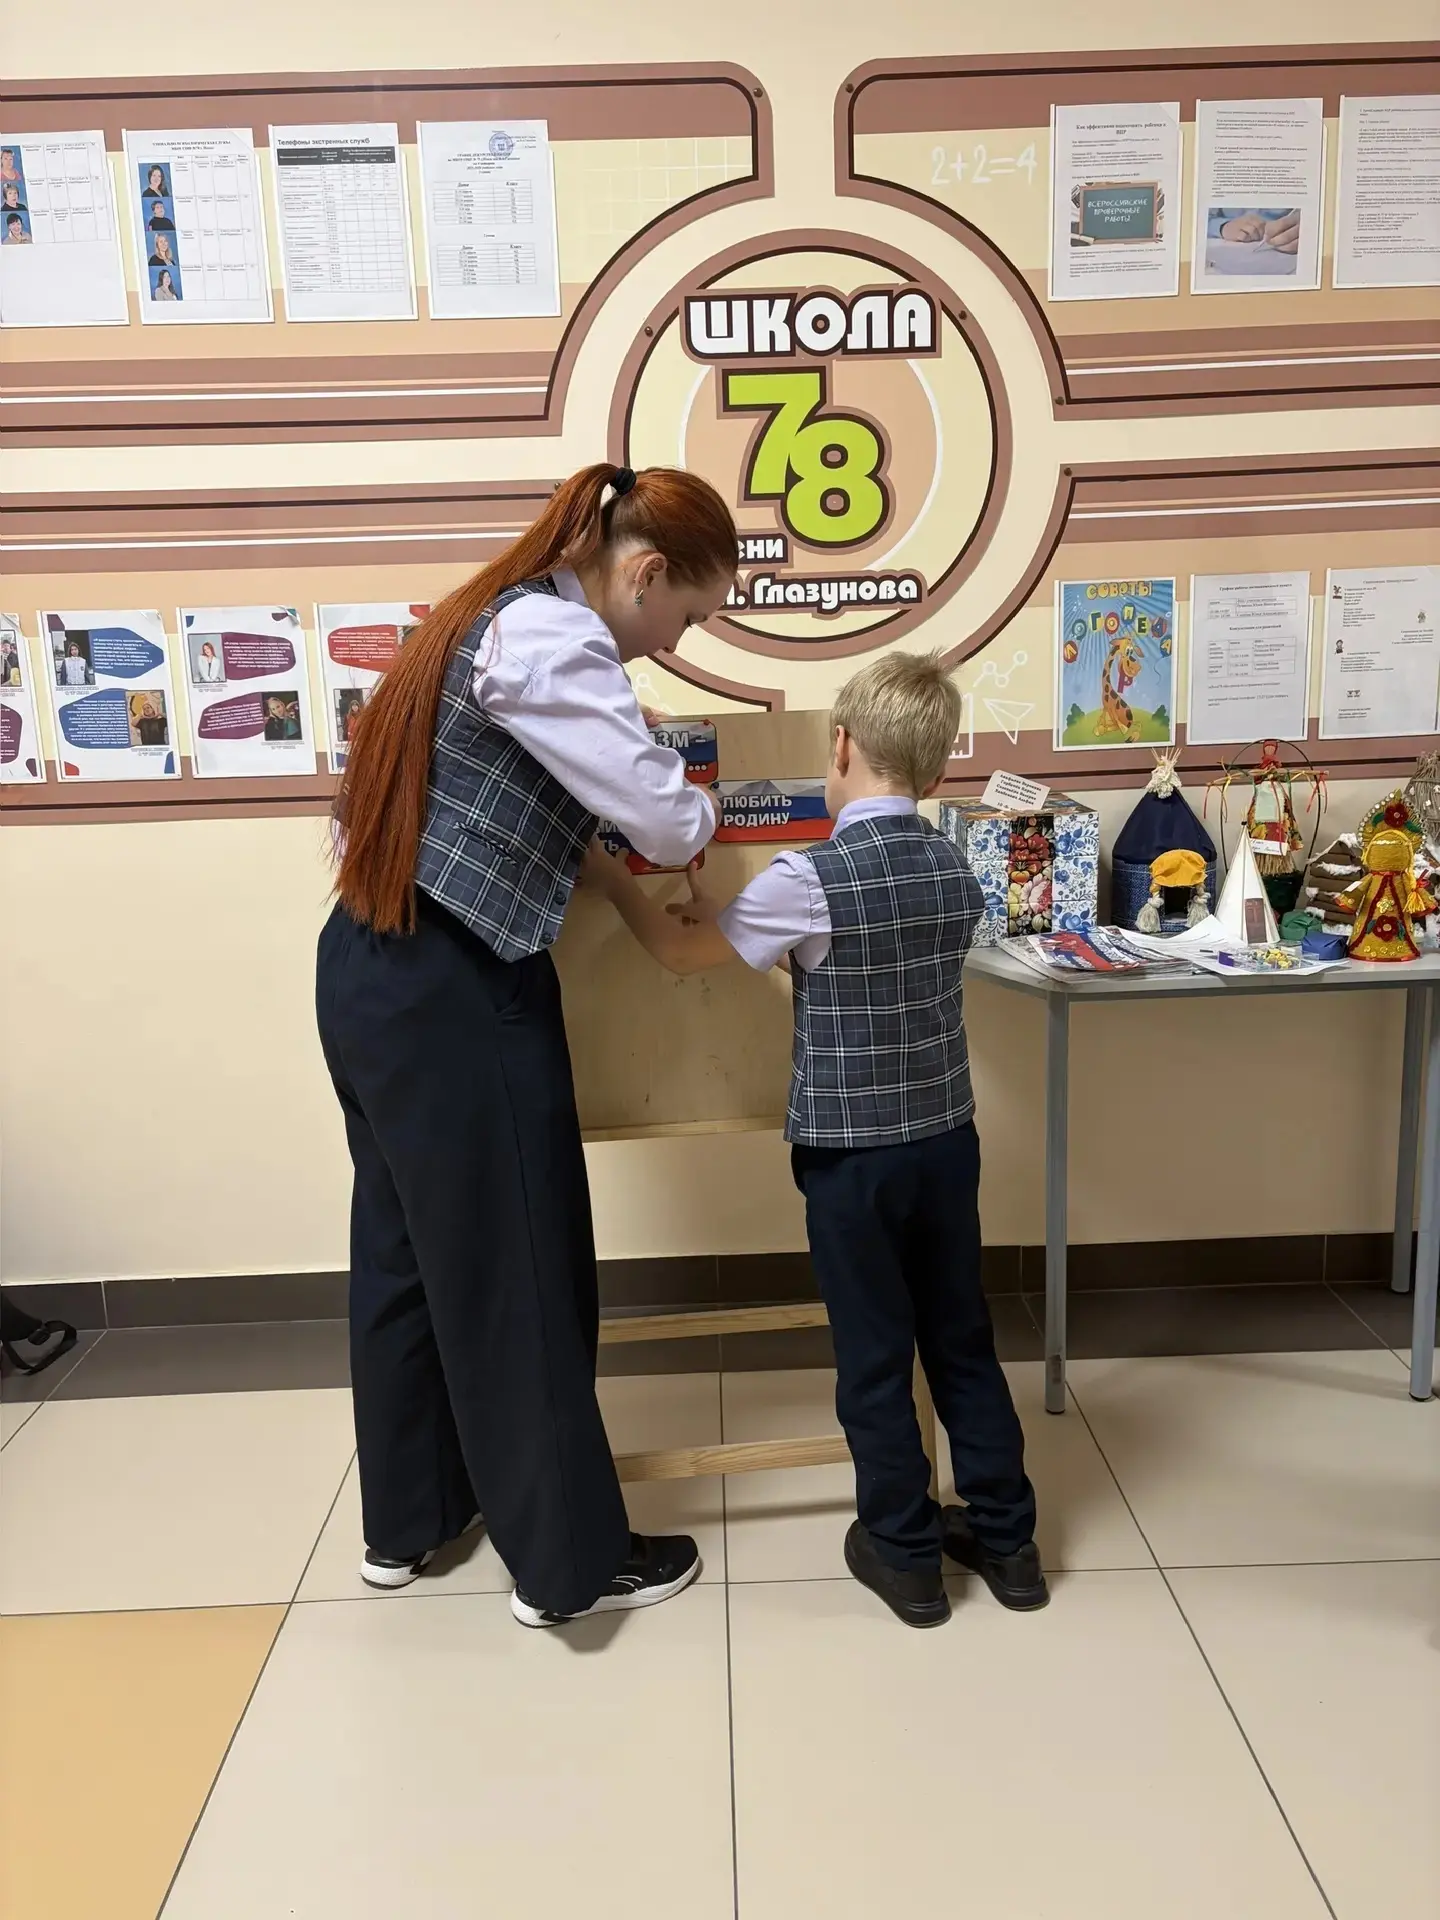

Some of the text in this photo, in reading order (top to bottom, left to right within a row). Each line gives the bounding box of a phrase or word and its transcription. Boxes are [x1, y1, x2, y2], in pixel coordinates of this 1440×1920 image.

[312, 138, 349, 146] экстренных
[350, 137, 370, 145] служб
[931, 142, 1038, 186] 2+2=4
[1087, 198, 1148, 208] ВСЕРОССИЙСКИЕ
[1094, 206, 1140, 216] ПРОВЕРОЧНЫЕ
[1105, 214, 1131, 223] РАБОТЫ
[689, 293, 932, 354] ШКОЛА
[728, 372, 884, 542] 78
[754, 578, 918, 610] Глазунова
[1086, 580, 1153, 600] СОВЕТЫ
[722, 795, 793, 809] ЛЮБИТЬ
[723, 812, 790, 828] РОДИНУ
